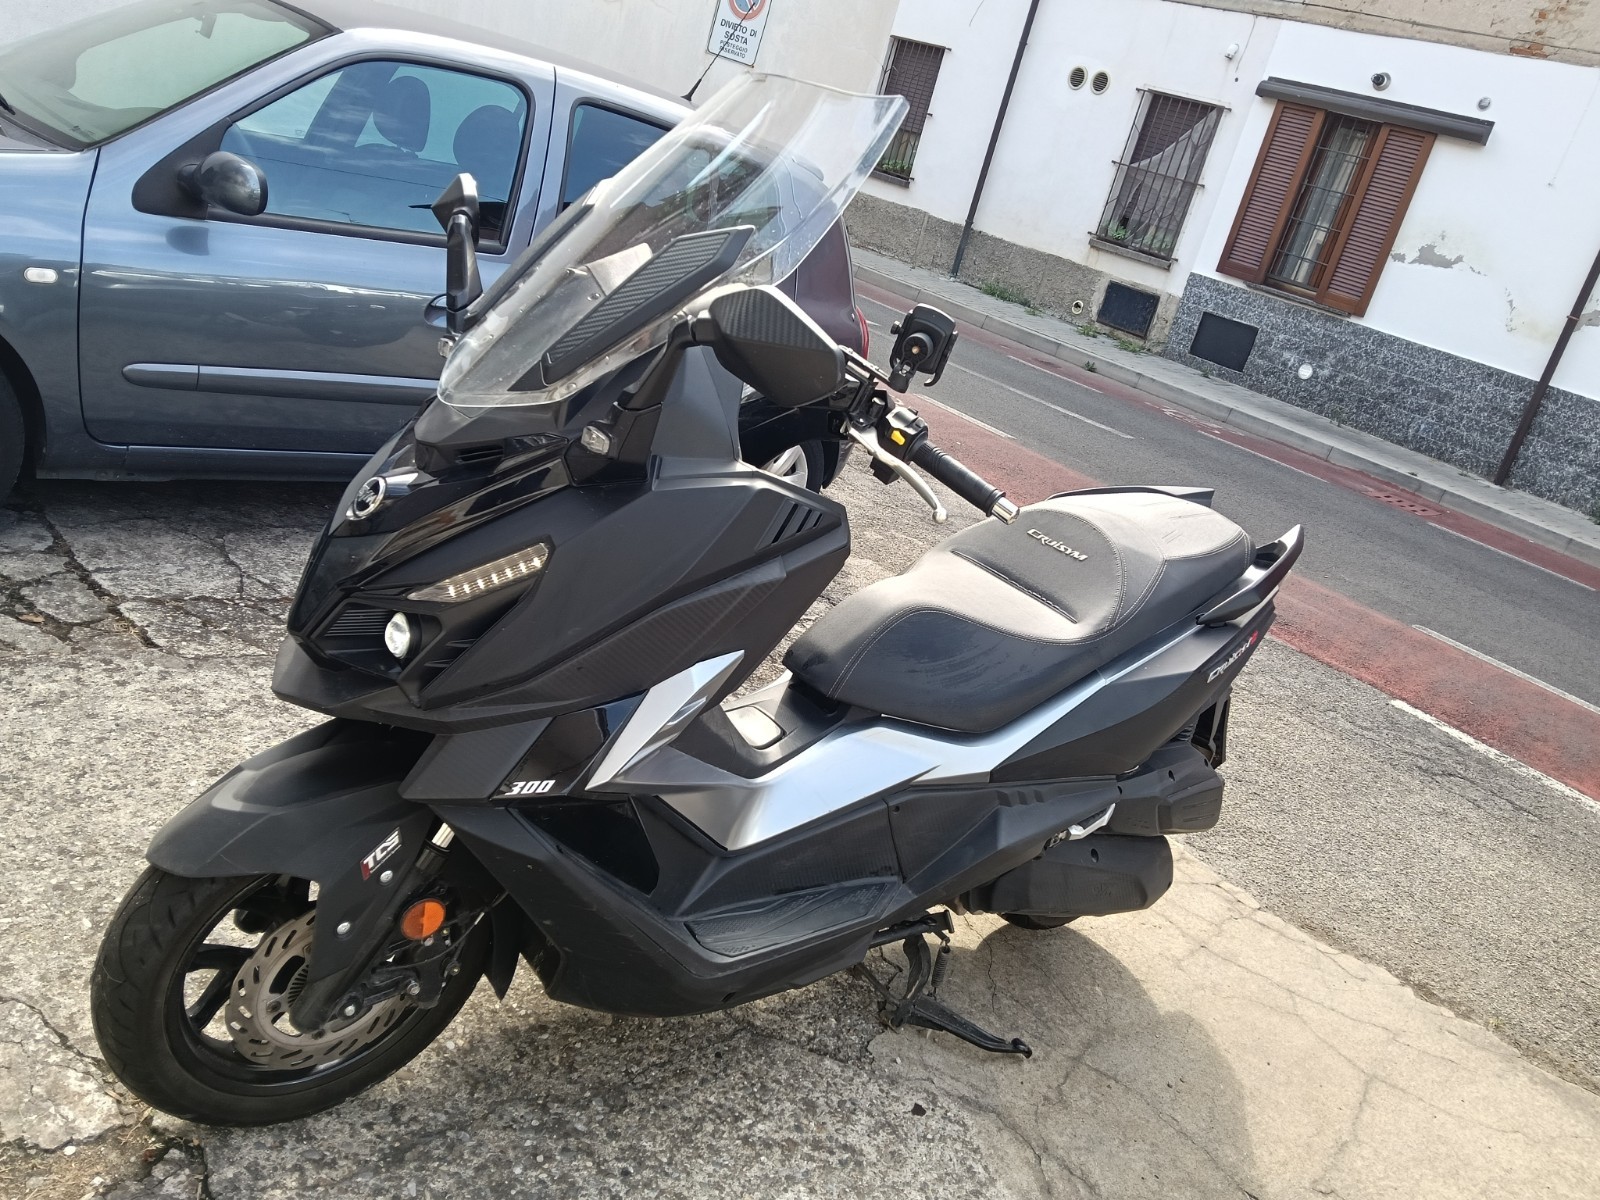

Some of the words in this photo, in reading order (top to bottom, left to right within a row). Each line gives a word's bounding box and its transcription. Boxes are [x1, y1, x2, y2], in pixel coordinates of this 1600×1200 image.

[720, 18, 748, 35] DIVIETO
[749, 28, 758, 38] DI
[723, 30, 749, 46] SOSTA
[504, 779, 556, 796] 300
[363, 830, 400, 870] TCS
